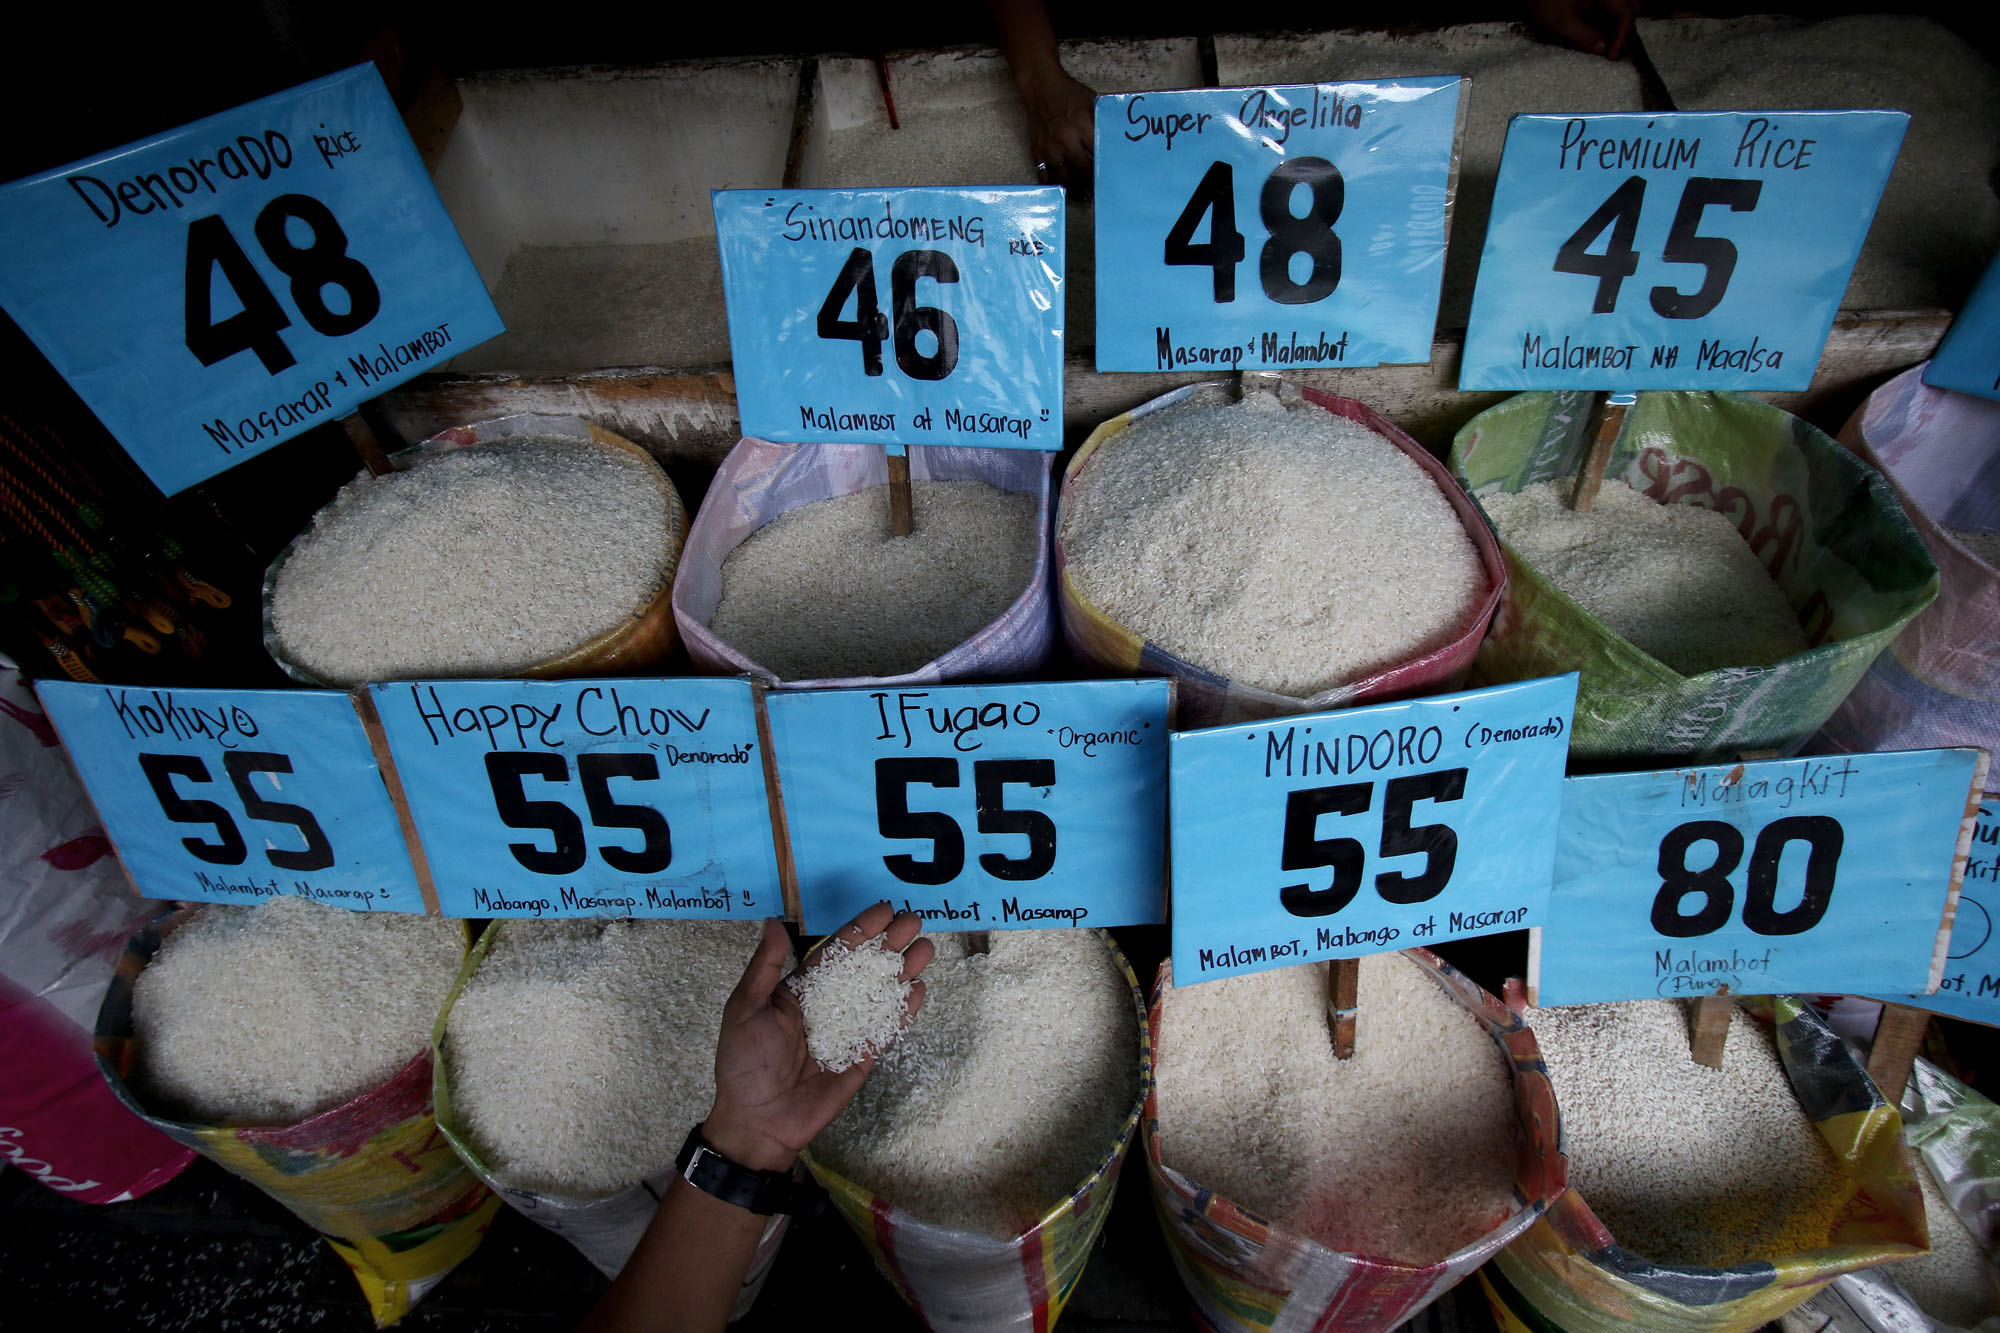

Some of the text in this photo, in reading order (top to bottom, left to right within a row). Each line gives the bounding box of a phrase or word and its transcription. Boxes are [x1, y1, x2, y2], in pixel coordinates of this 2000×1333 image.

[1124, 95, 1212, 150] Super
[1164, 156, 1345, 305] 48
[1553, 174, 1763, 319] 45
[184, 193, 381, 376] 48
[817, 247, 960, 381] 46
[1156, 327, 1243, 371] Masarap
[1261, 331, 1349, 364] Malambot
[202, 381, 332, 454] Masarap
[913, 407, 932, 430] at
[946, 409, 1031, 439] Masarap
[411, 685, 711, 750] Happy Chow
[138, 751, 335, 871] 55
[484, 751, 672, 875] 55
[875, 757, 1056, 886] 55
[1280, 767, 1468, 917] 55
[194, 871, 281, 896] Malambot
[645, 887, 732, 912] Malambot
[1002, 896, 1089, 927] Masarap
[1650, 815, 1845, 938] 80
[1316, 926, 1400, 951] Mabango
[1412, 915, 1438, 937] at
[1655, 948, 1771, 977] Malambot
